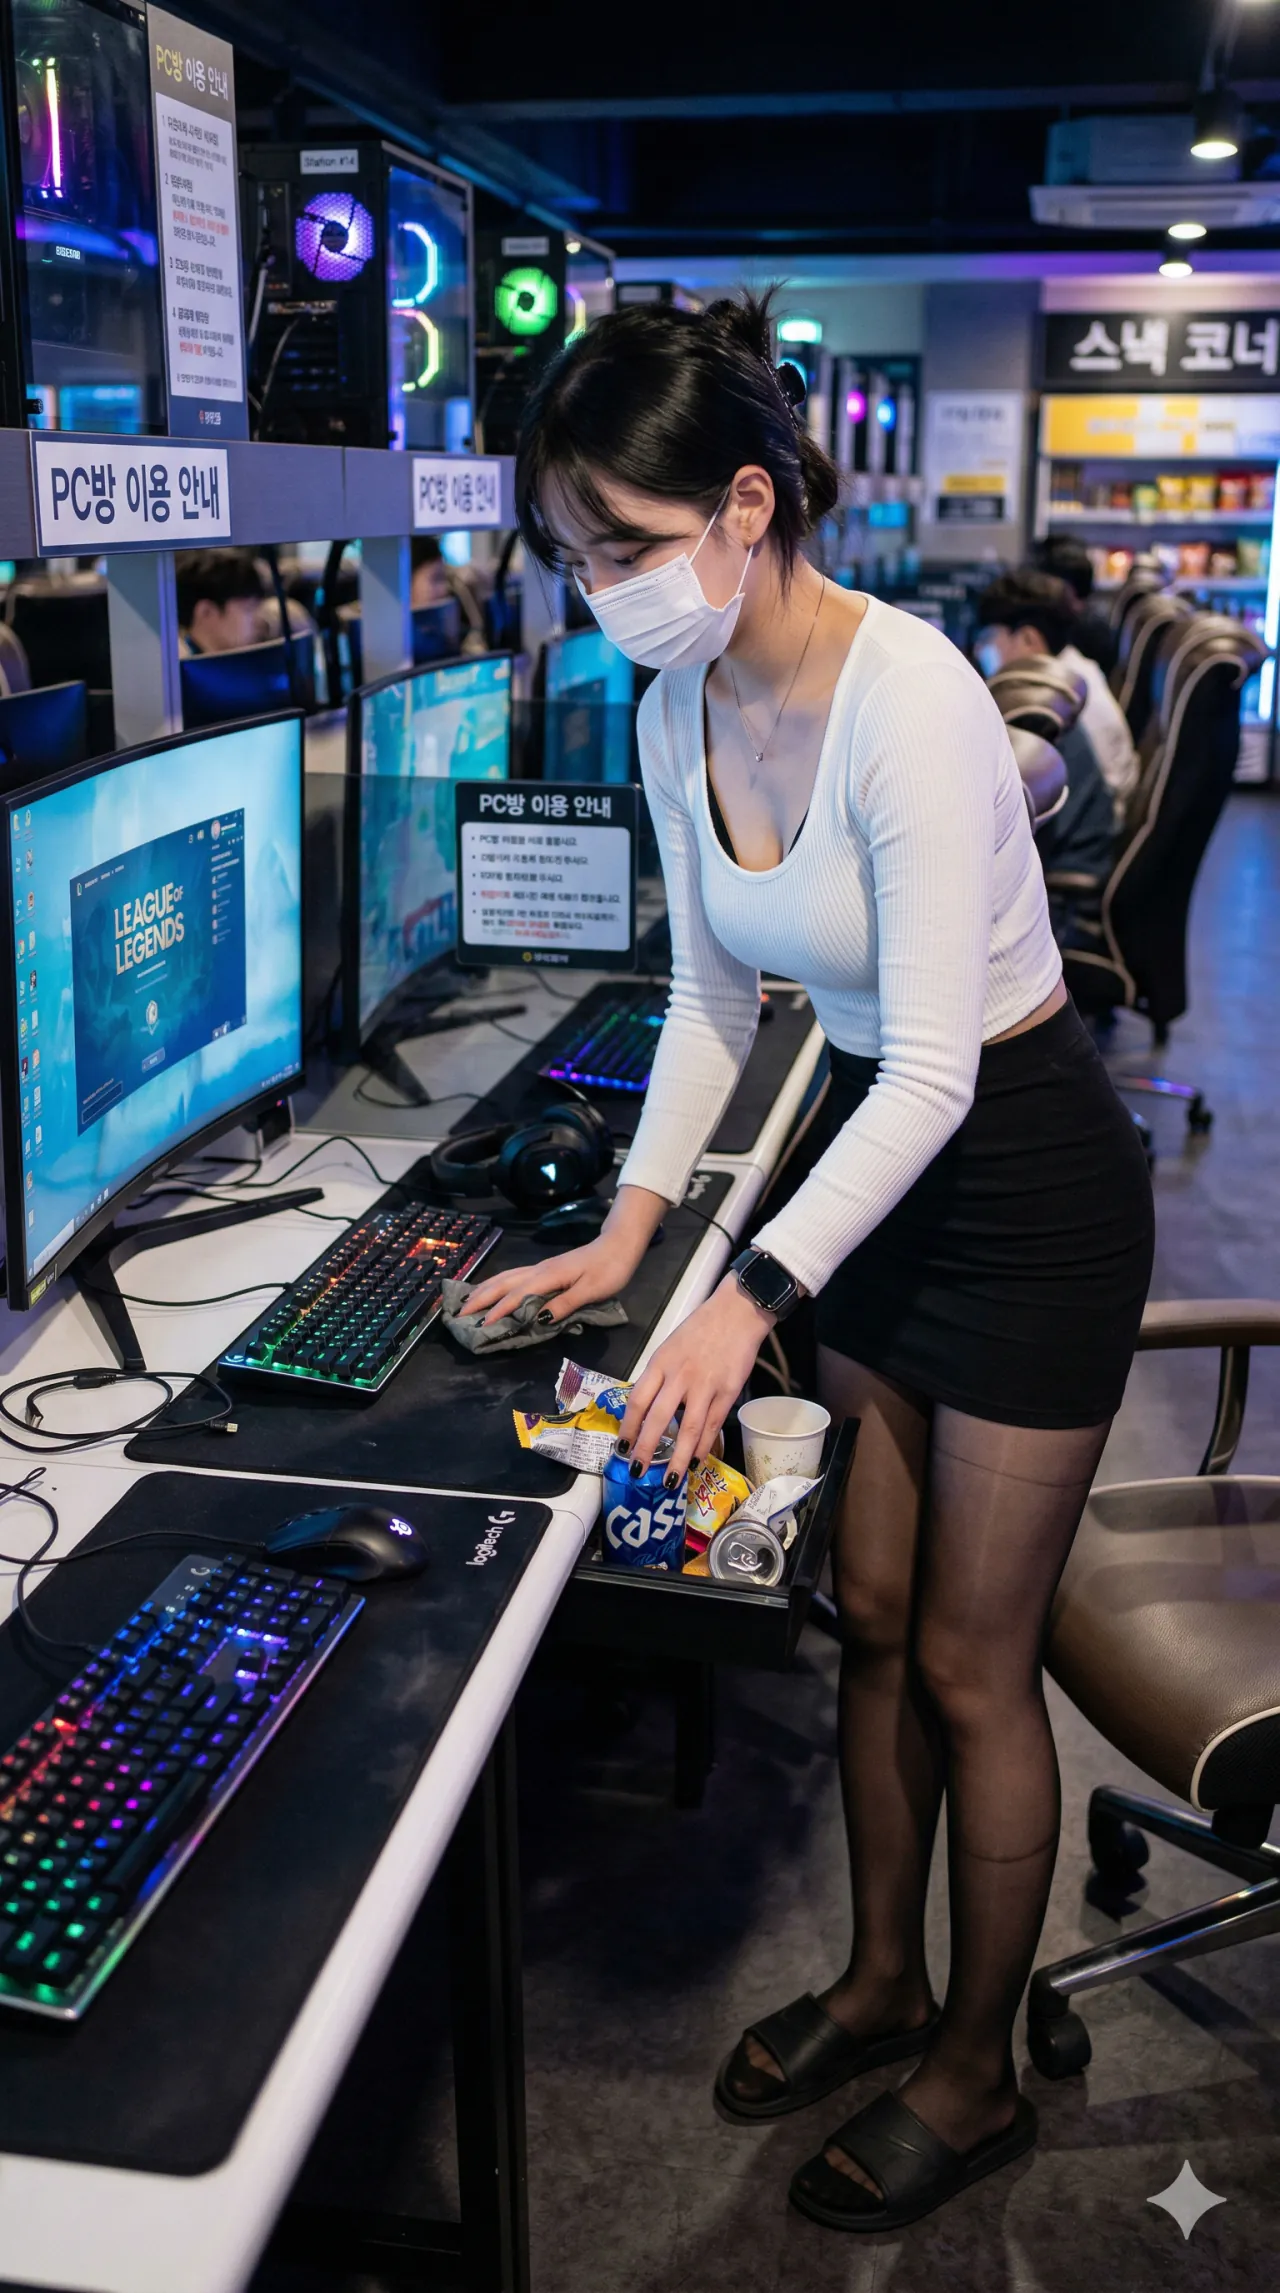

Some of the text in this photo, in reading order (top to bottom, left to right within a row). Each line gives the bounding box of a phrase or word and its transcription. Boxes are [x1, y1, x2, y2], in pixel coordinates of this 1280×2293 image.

[155, 44, 229, 101] PC방 이용 안내
[1069, 317, 1280, 376] 스낵 코너
[51, 463, 220, 525] PC방 이용 안내
[419, 472, 496, 515] PC방 이용 안내
[479, 793, 612, 820] PC방 이용 안내
[114, 881, 184, 940] LEAGUE OF
[114, 911, 185, 976] LEGENDS
[465, 1526, 504, 1566] logitech
